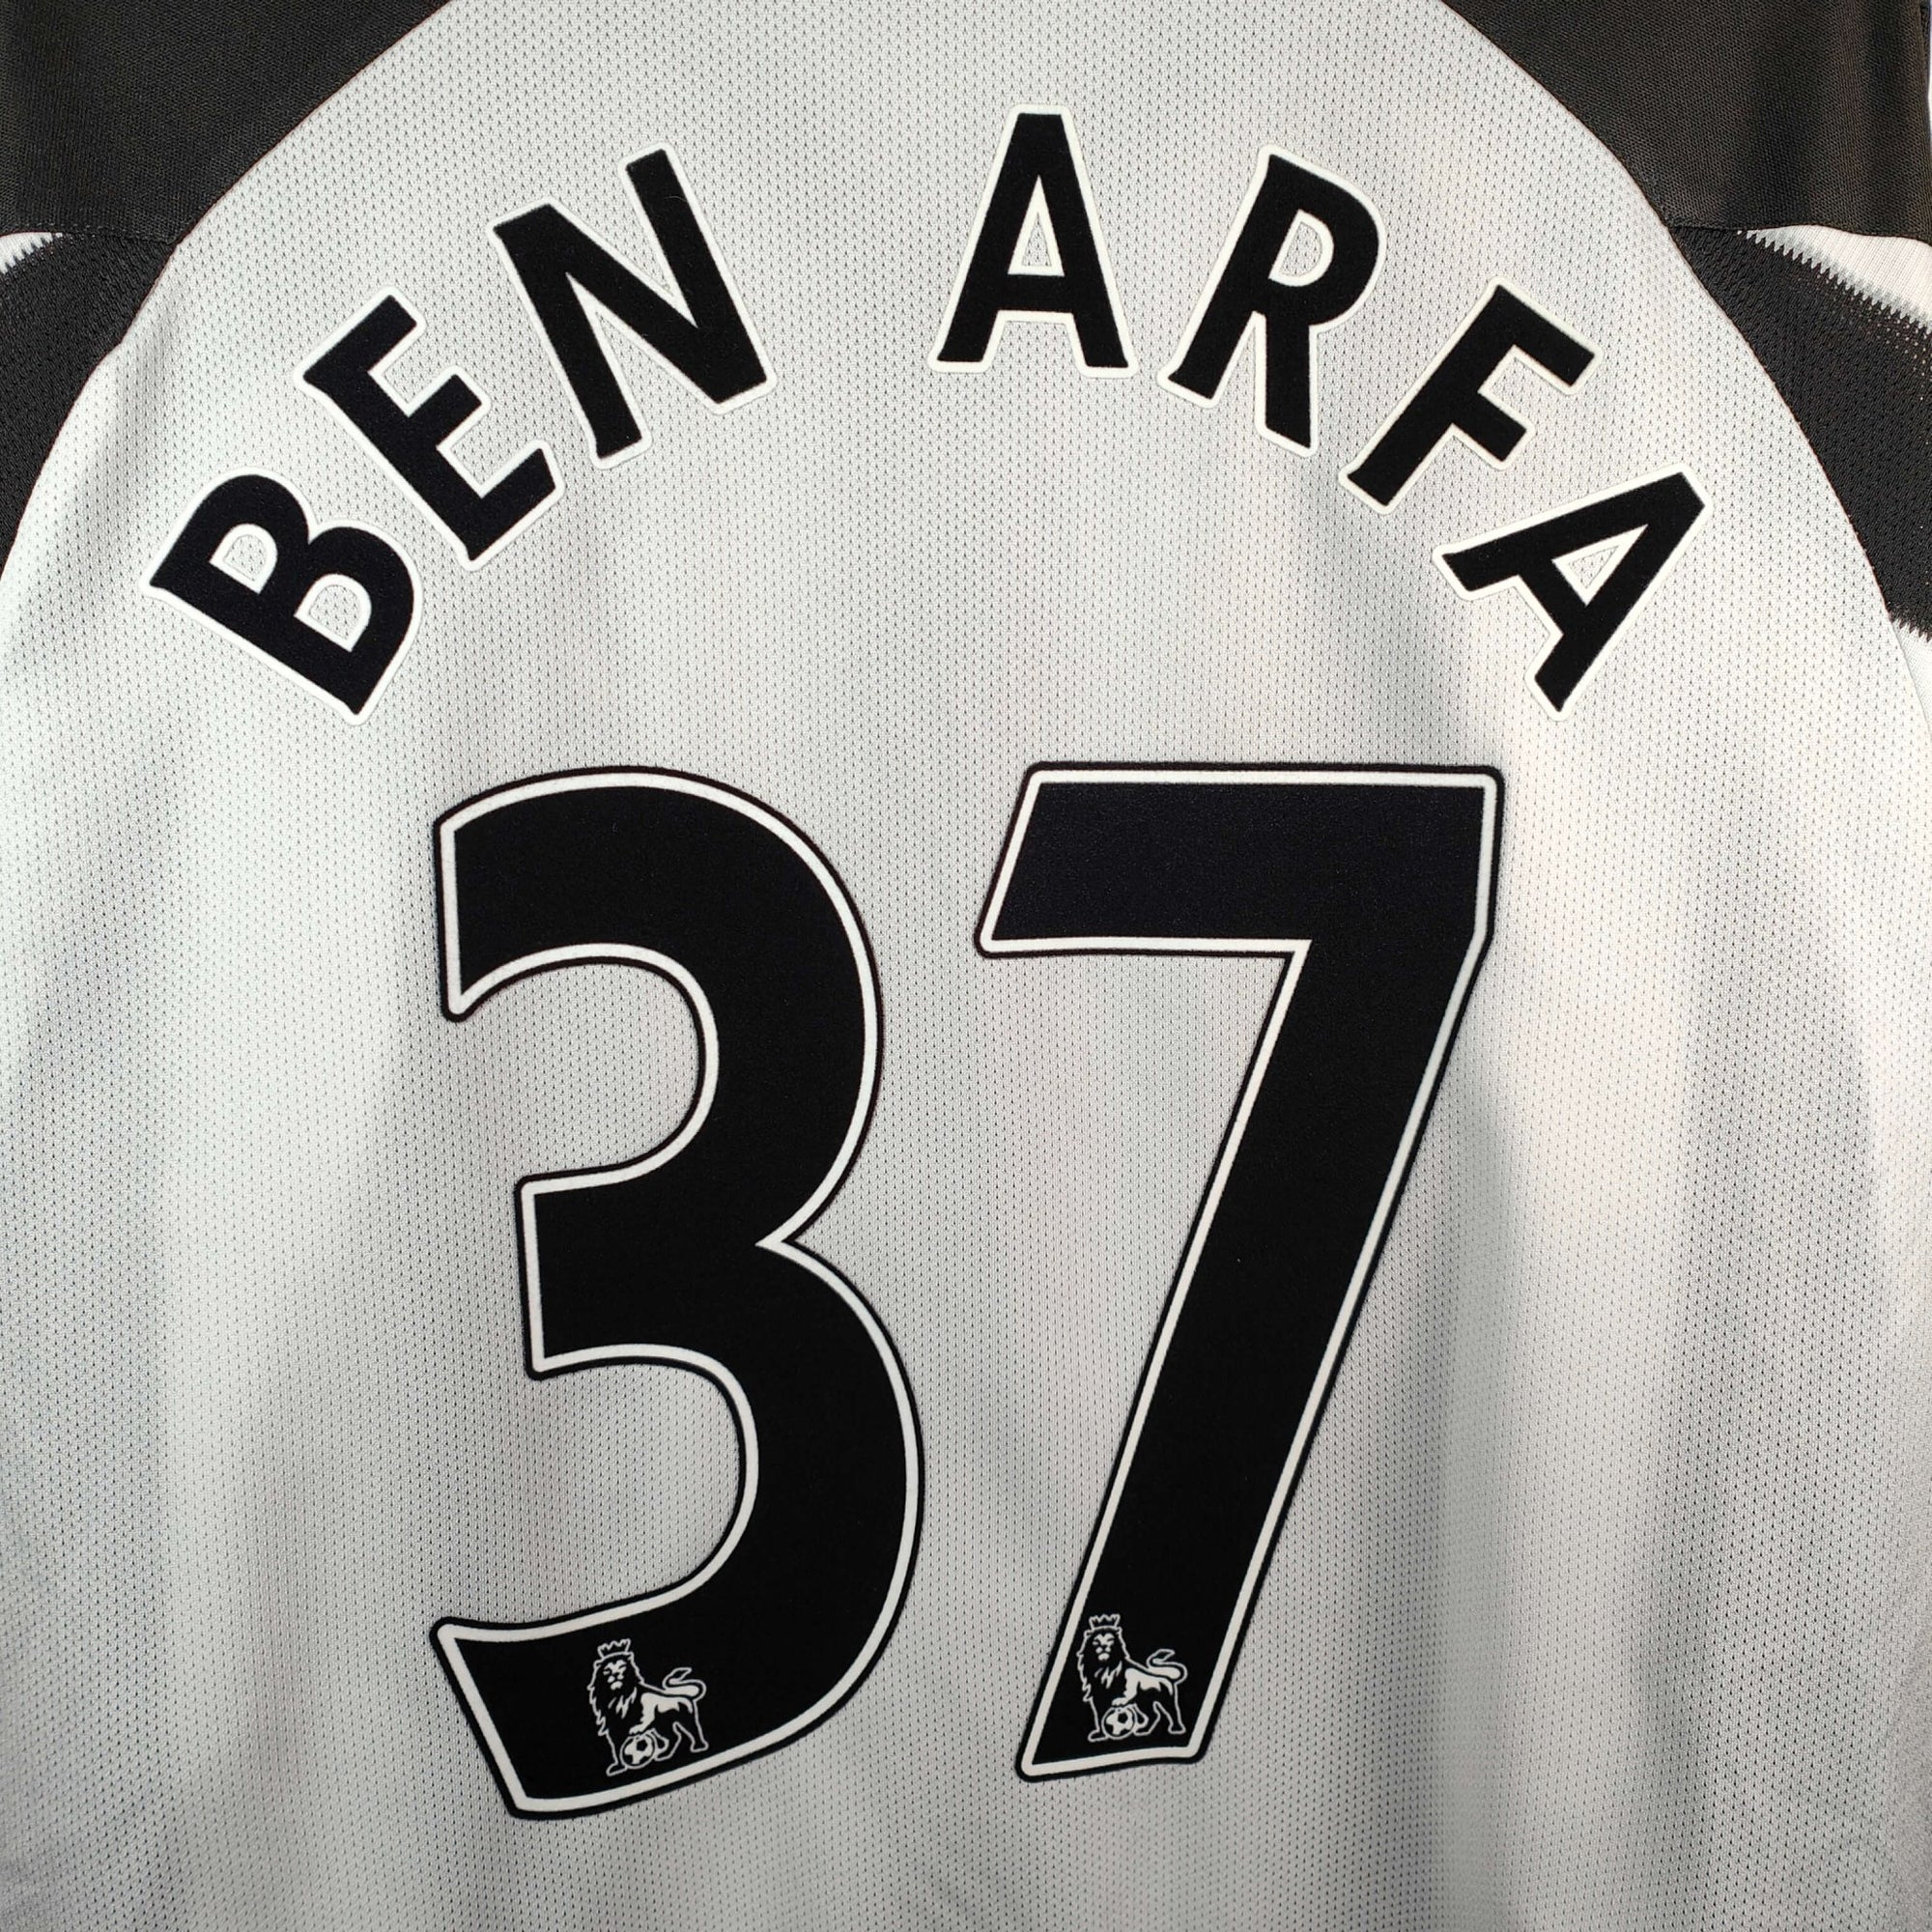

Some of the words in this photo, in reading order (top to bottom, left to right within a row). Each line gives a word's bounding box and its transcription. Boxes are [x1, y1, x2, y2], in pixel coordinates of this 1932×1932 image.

[146, 145, 771, 720] BEN
[933, 109, 1708, 715] ARFA
[429, 761, 1505, 1822] 37
